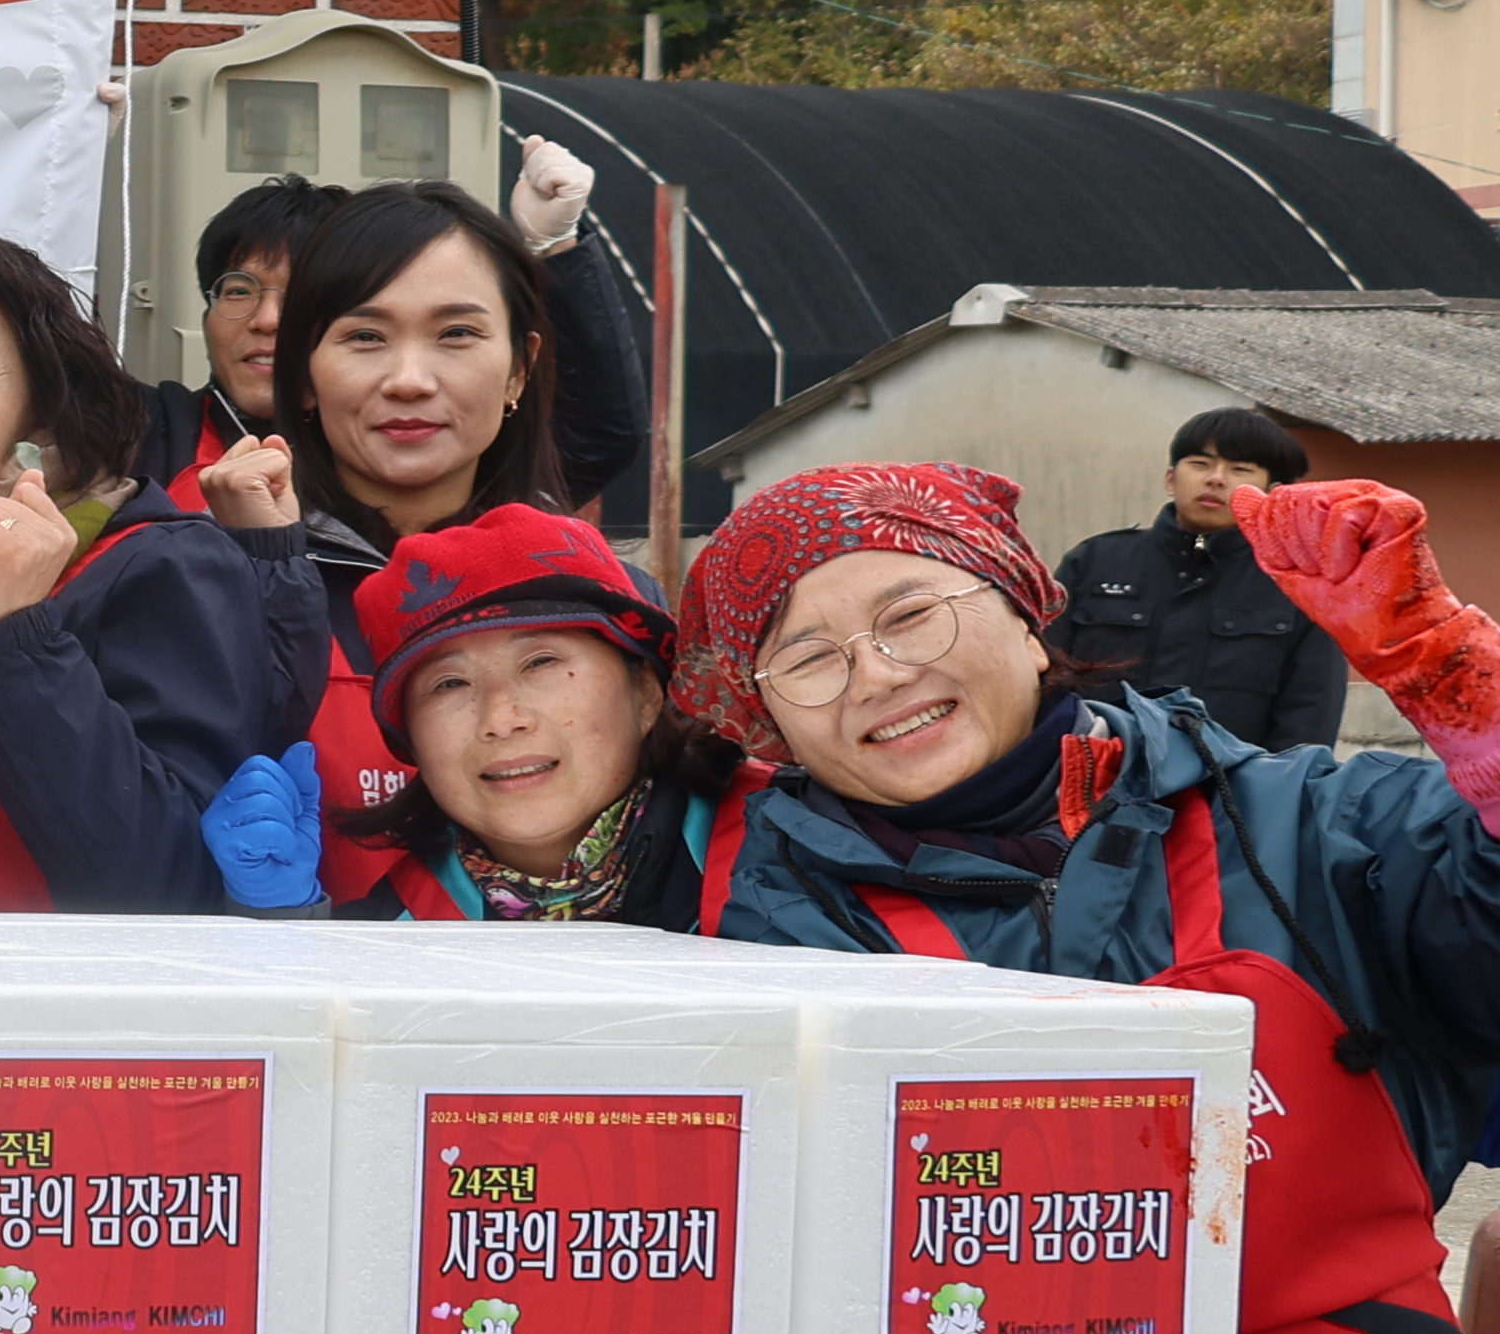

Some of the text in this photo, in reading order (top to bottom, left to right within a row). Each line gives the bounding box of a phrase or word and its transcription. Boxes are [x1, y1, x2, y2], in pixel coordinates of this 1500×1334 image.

[449, 1166, 536, 1201] 24주년
[919, 1152, 1000, 1187] 24주년
[441, 1208, 717, 1282] 사랑의 김장김치
[910, 1189, 1170, 1266] 사랑의 김장김치
